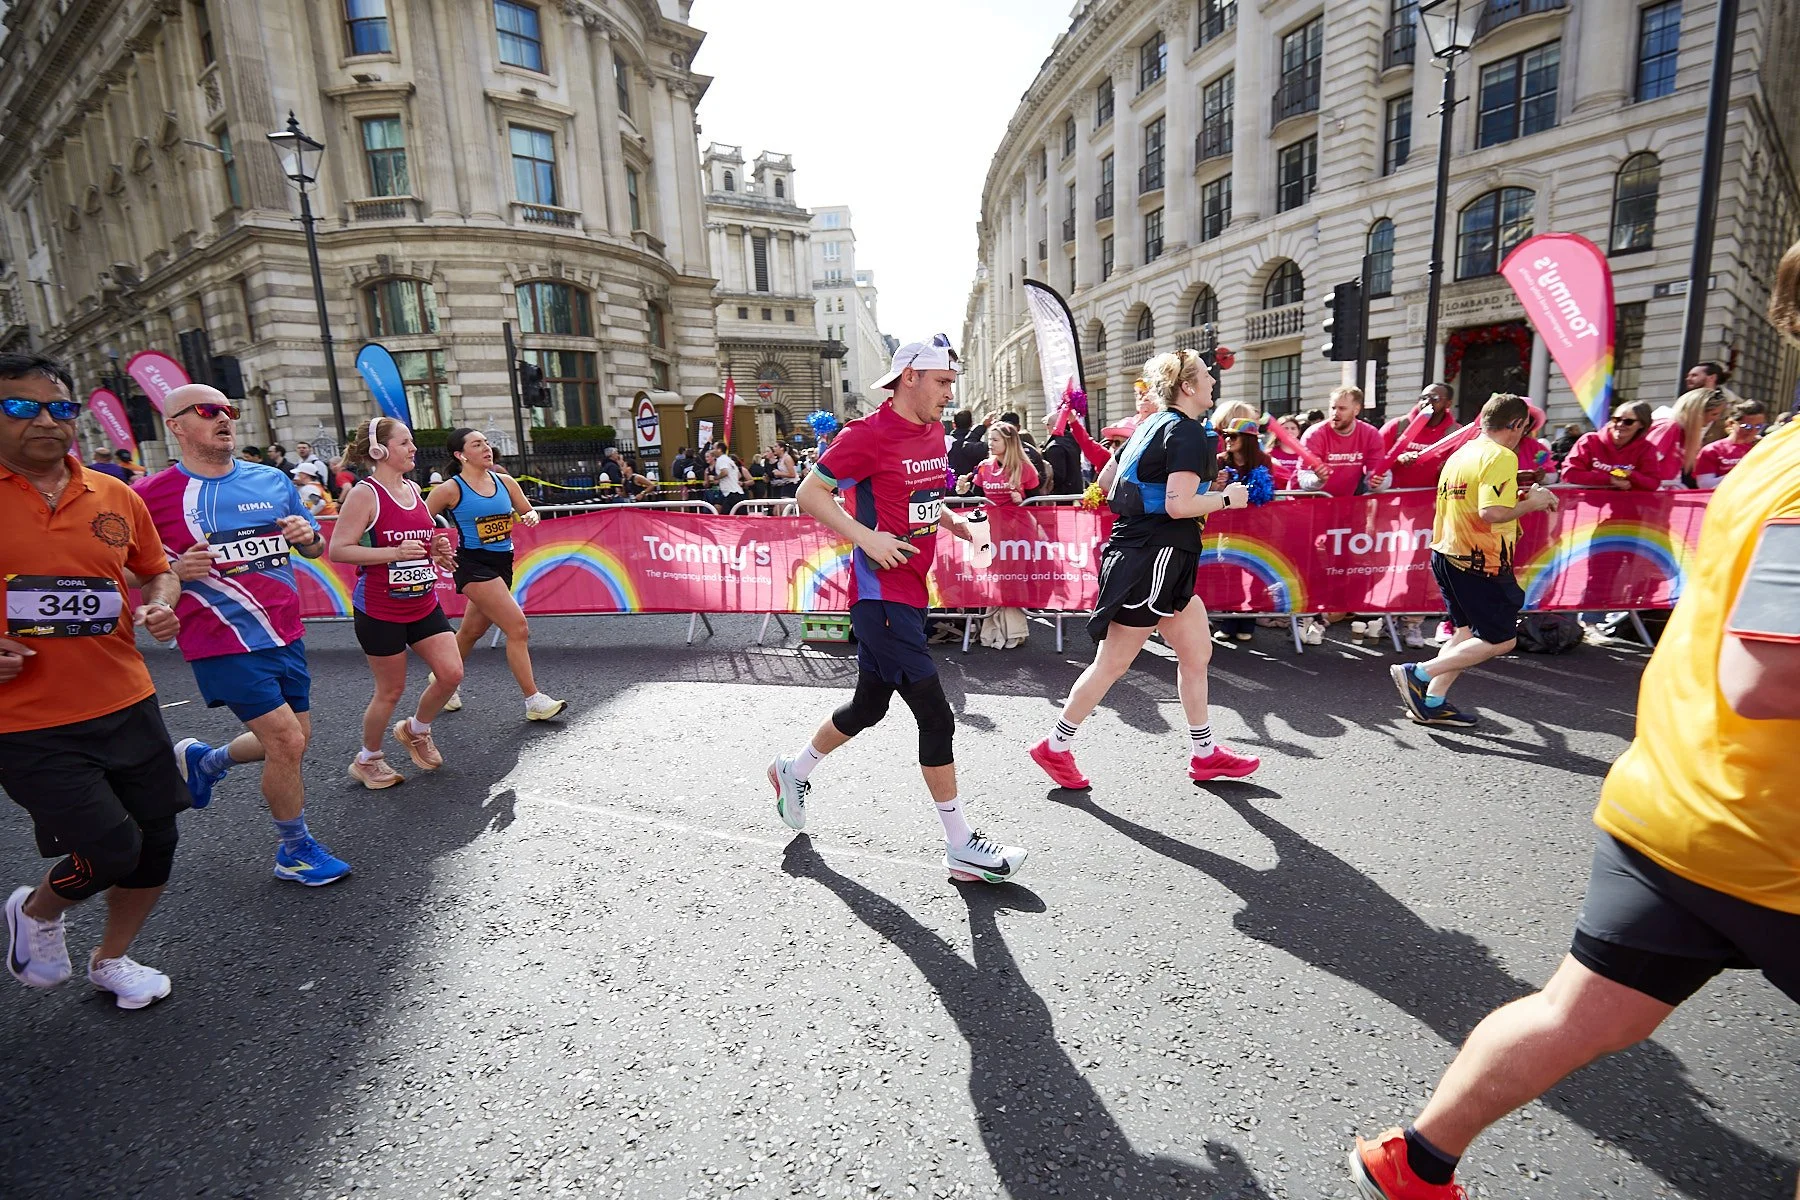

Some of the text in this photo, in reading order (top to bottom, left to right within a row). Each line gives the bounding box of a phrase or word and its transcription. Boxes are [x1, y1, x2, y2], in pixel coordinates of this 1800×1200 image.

[1445, 294, 1500, 311] LOMBARD
[1327, 452, 1363, 462] ommy's
[238, 501, 274, 512] KIMAL
[237, 529, 255, 537] ANDY
[484, 520, 509, 534] 3987
[218, 538, 280, 560] 11917
[643, 535, 771, 571] Tommy's
[1326, 567, 1344, 576] The
[1346, 564, 1404, 576] pregnancy
[56, 579, 87, 587] GOPAL
[645, 569, 661, 578] The
[663, 571, 700, 582] pregnancy
[702, 573, 717, 582] and
[742, 574, 772, 586] charity
[956, 573, 973, 582] The
[975, 573, 1029, 584] pregnancy
[1031, 571, 1051, 581] and
[1053, 571, 1080, 583] baby
[38, 594, 101, 616] 349
